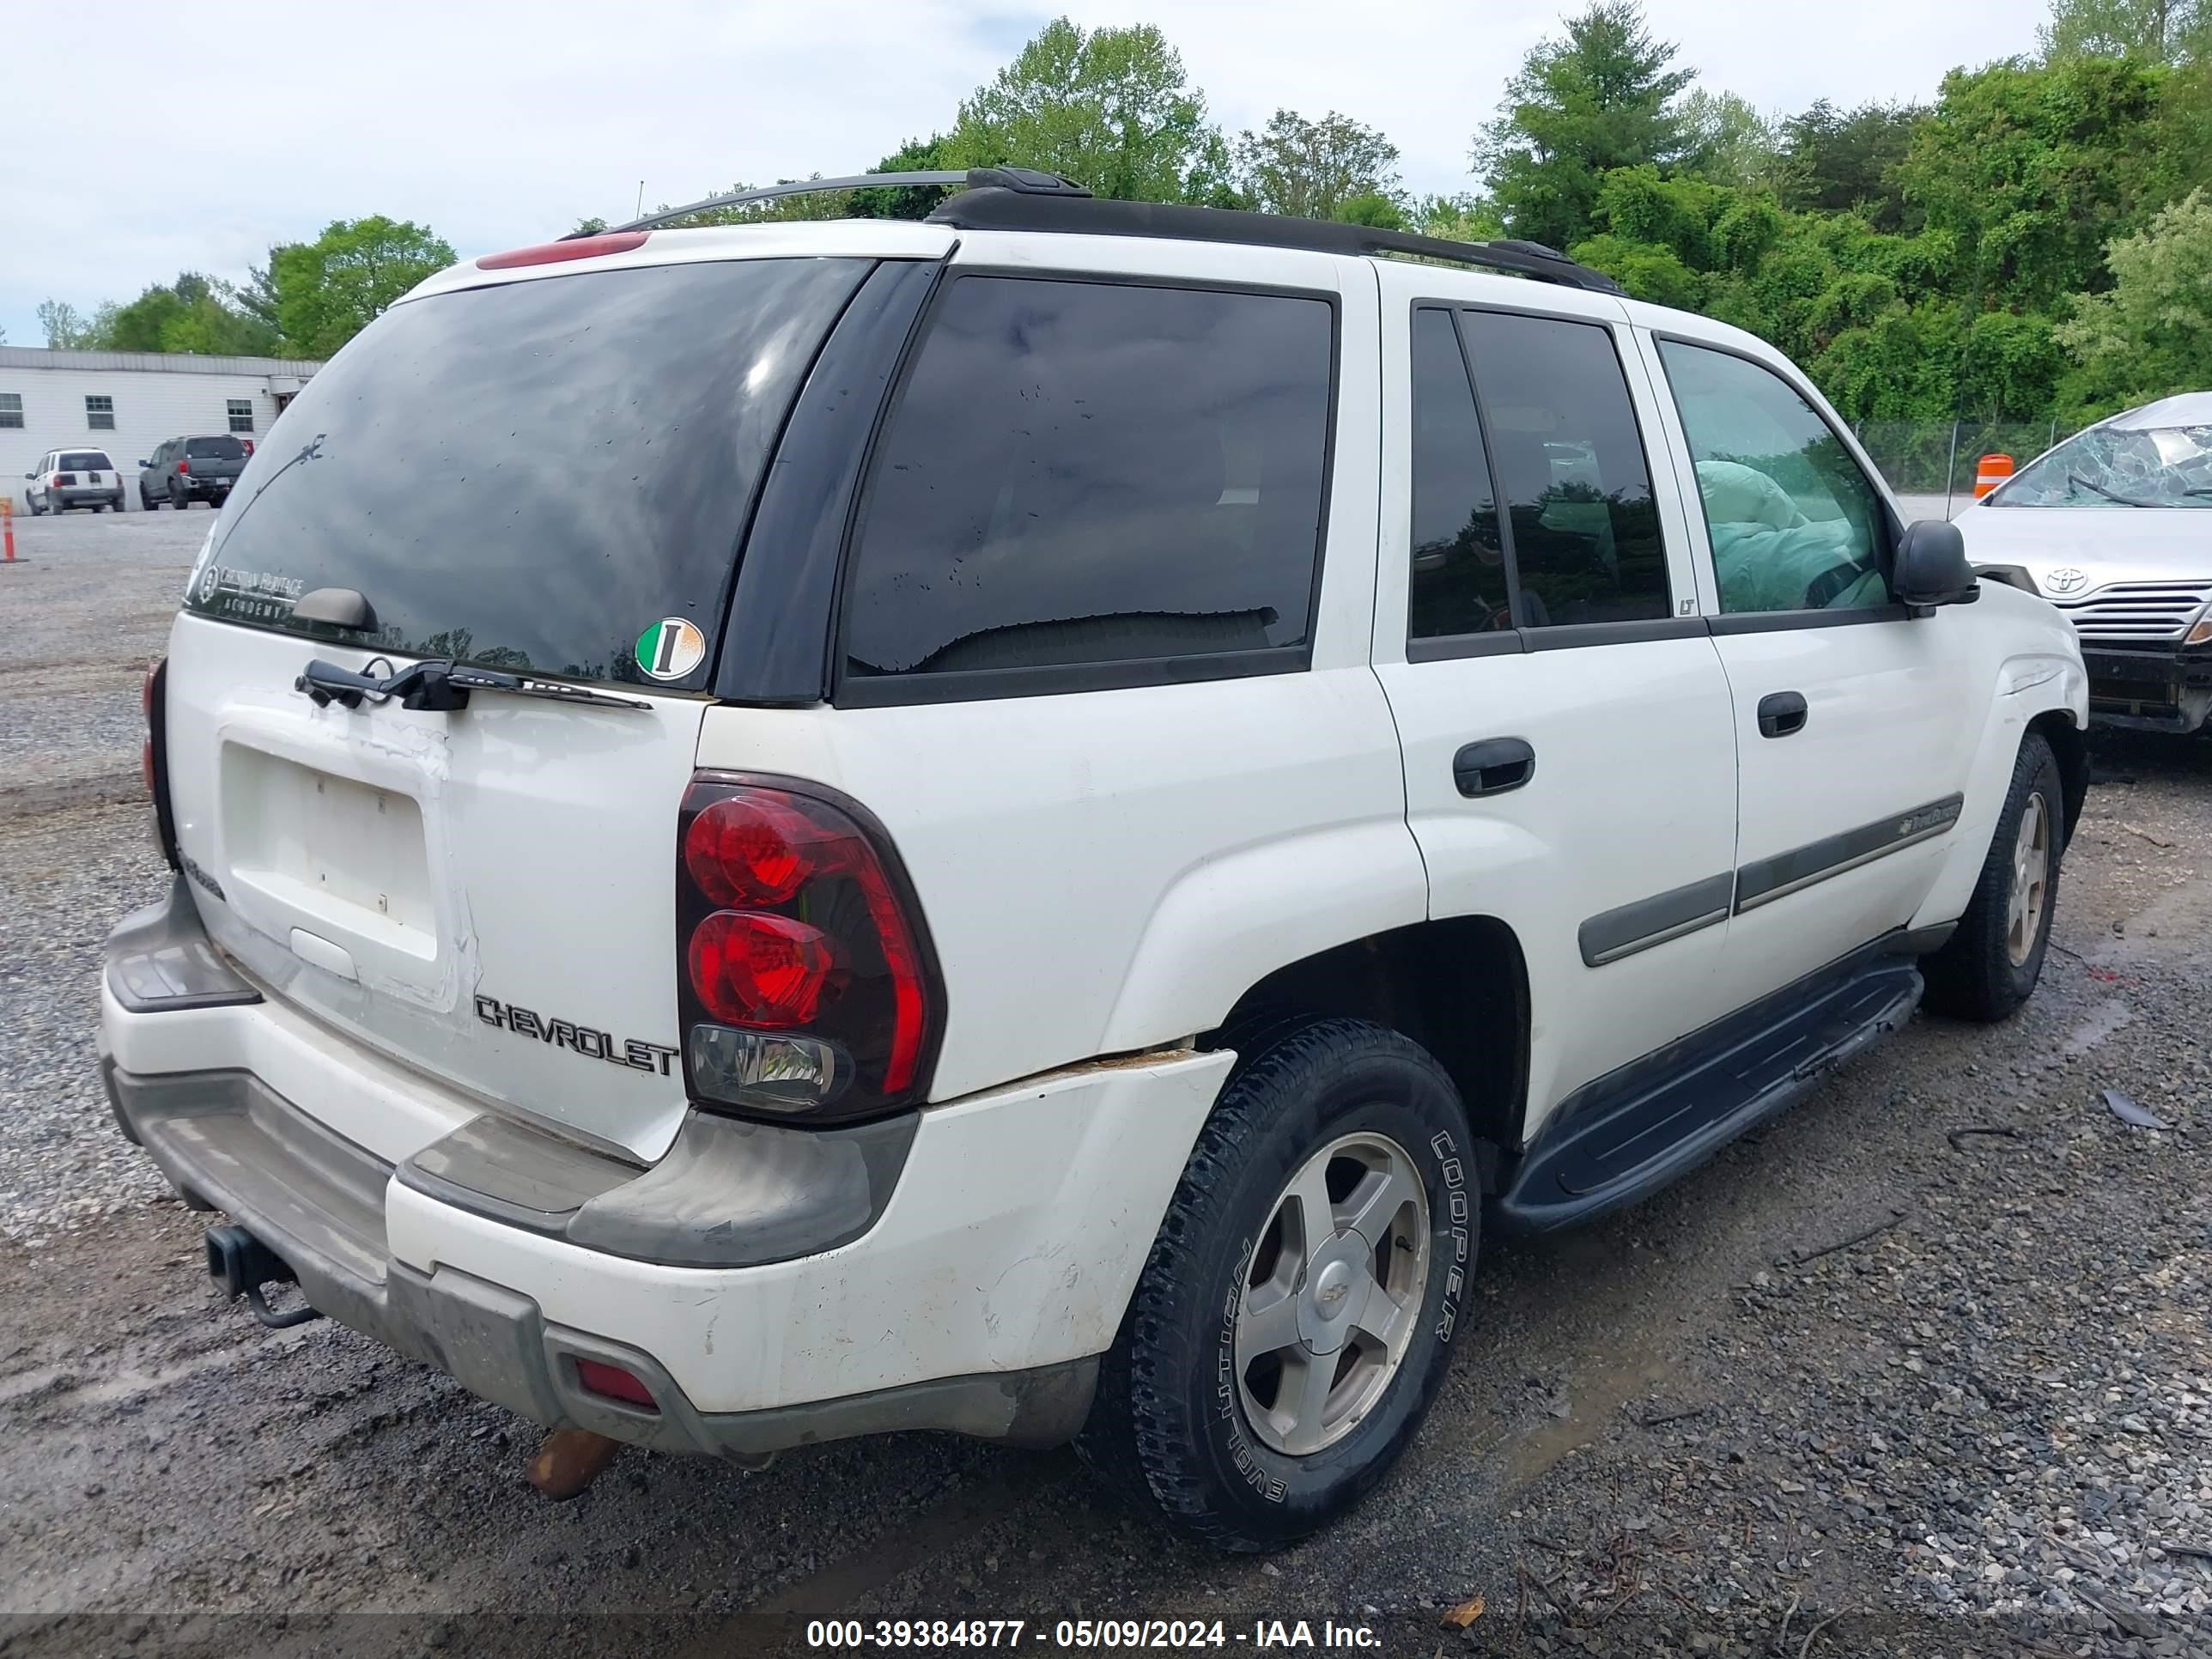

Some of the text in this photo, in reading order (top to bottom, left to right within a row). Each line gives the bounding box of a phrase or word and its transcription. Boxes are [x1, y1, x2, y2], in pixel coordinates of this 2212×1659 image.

[223, 598, 282, 619] ACADEMY
[1680, 599, 1695, 616] LT
[475, 994, 680, 1076] CHEVROLET
[1431, 1130, 1469, 1344] COOPER
[1217, 1238, 1289, 1504] EVOLUTION
